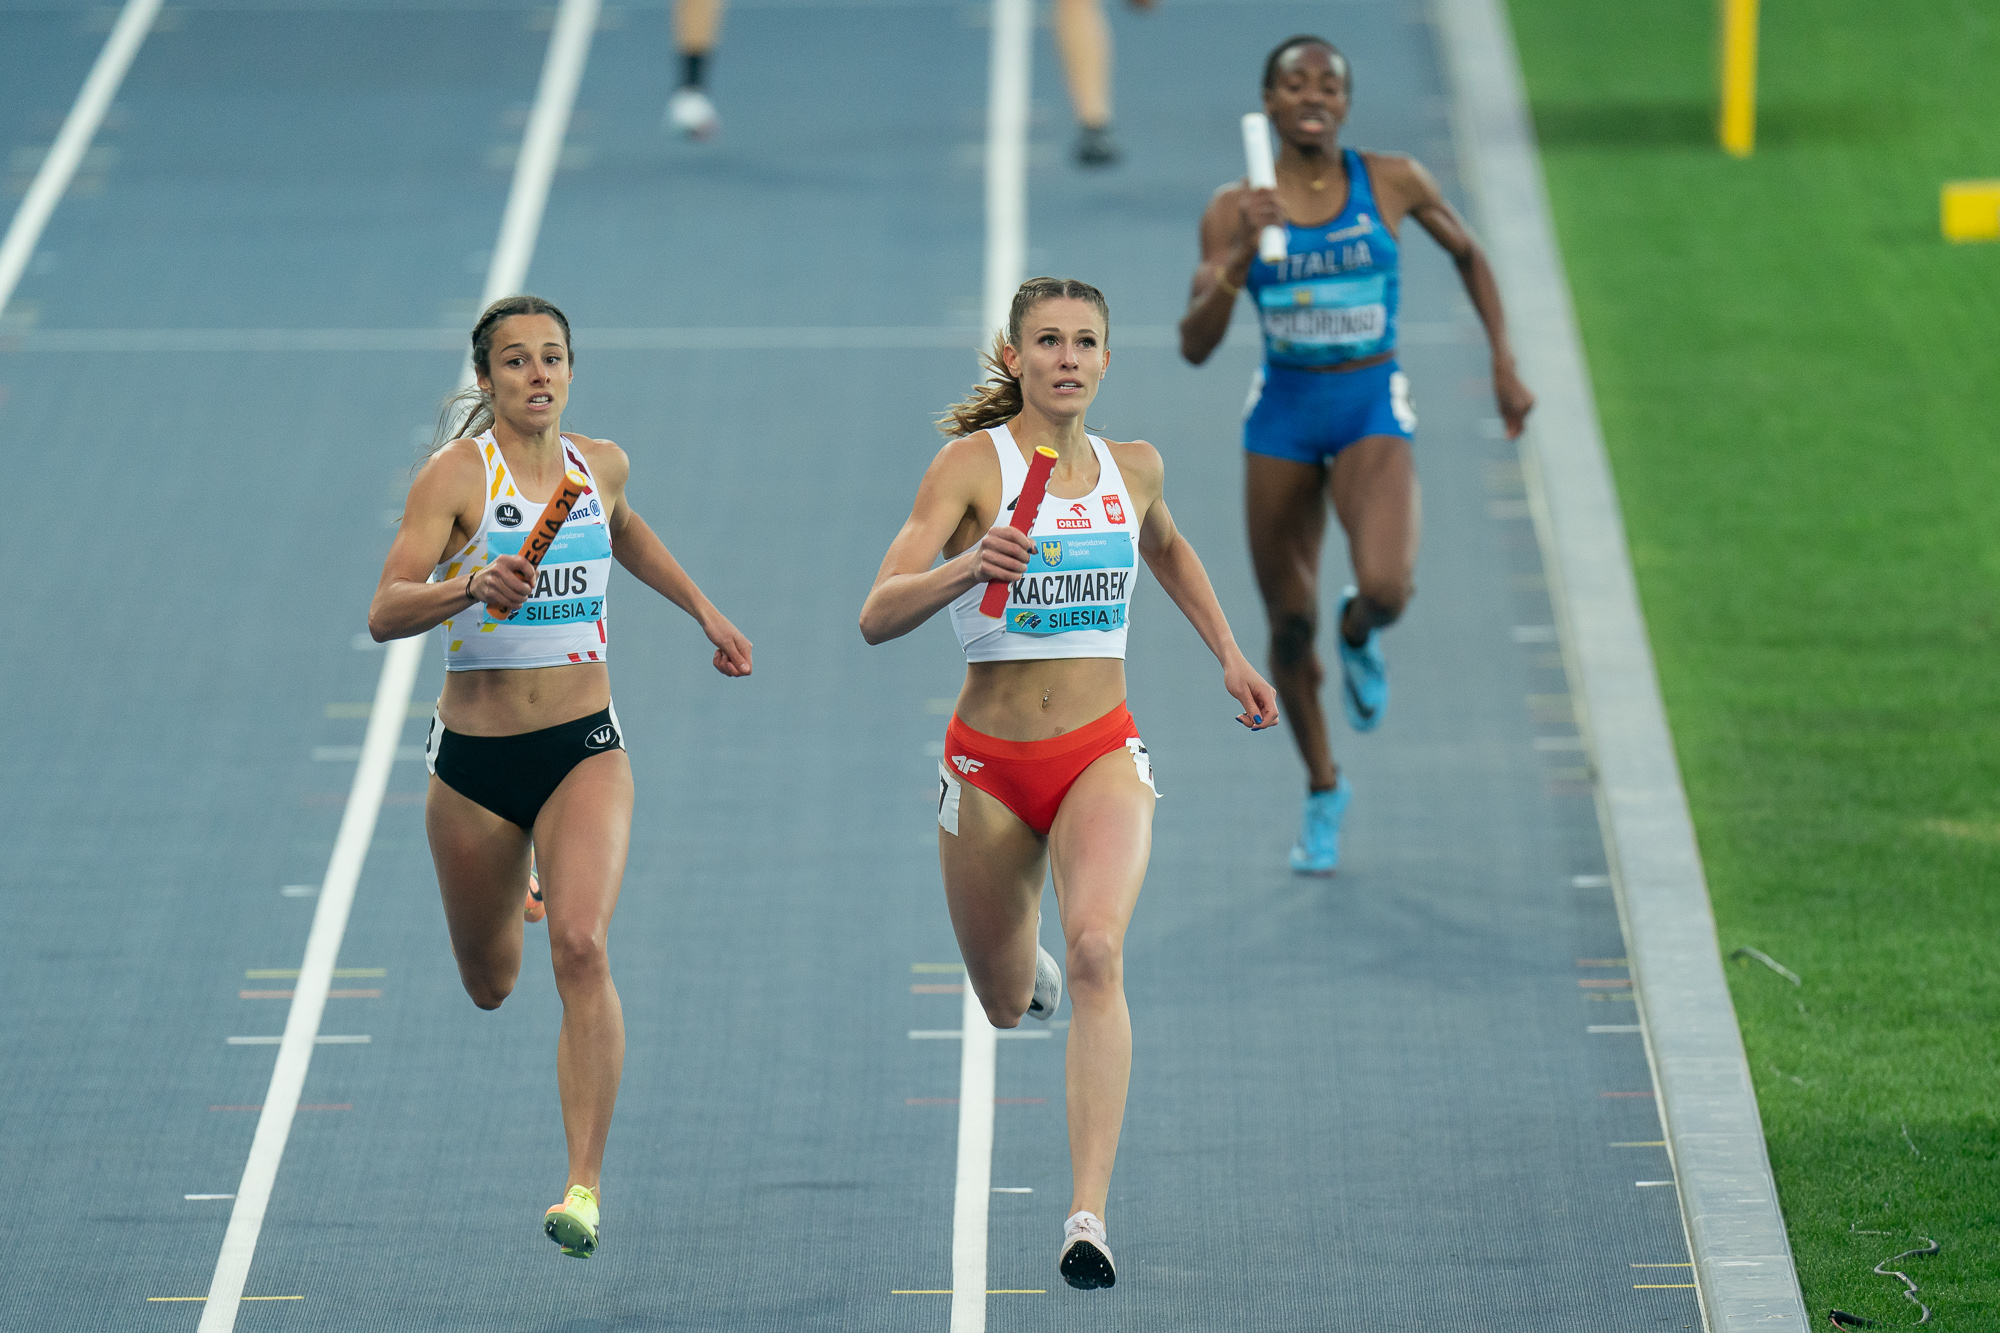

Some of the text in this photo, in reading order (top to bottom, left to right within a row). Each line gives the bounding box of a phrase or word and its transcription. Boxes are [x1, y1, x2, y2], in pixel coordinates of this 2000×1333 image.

[1276, 240, 1373, 283] ITALIA
[556, 488, 581, 516] 21
[1058, 521, 1090, 529] ORLEN
[528, 566, 587, 599] AUS
[1012, 571, 1129, 606] KACZMAREK
[526, 602, 586, 621] SILESIA
[1048, 608, 1120, 629] SILESIA 21
